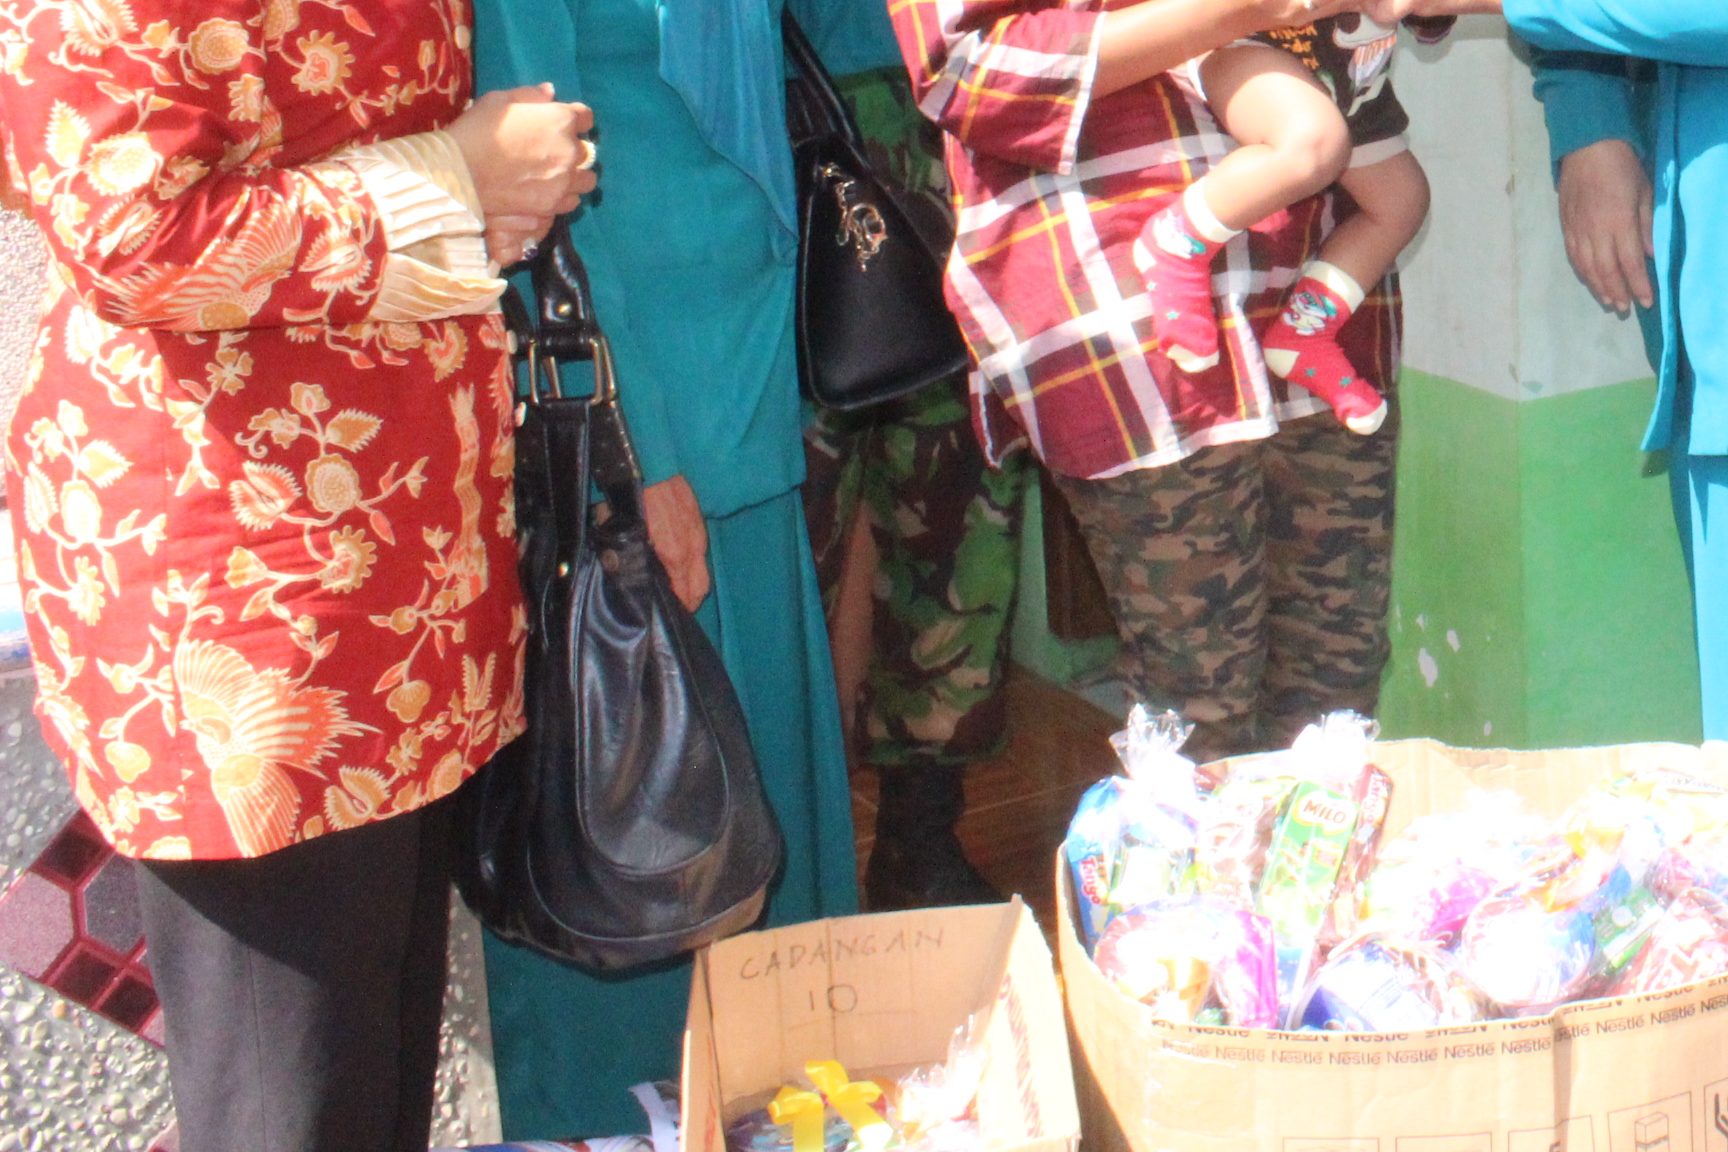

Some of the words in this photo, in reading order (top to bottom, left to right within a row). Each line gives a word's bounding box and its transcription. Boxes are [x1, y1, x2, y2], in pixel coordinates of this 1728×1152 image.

[1303, 800, 1347, 825] MILO
[1362, 772, 1387, 826] Tango
[1080, 855, 1101, 906] Tango
[739, 927, 945, 980] CADANGAN
[809, 983, 858, 1014] 10
